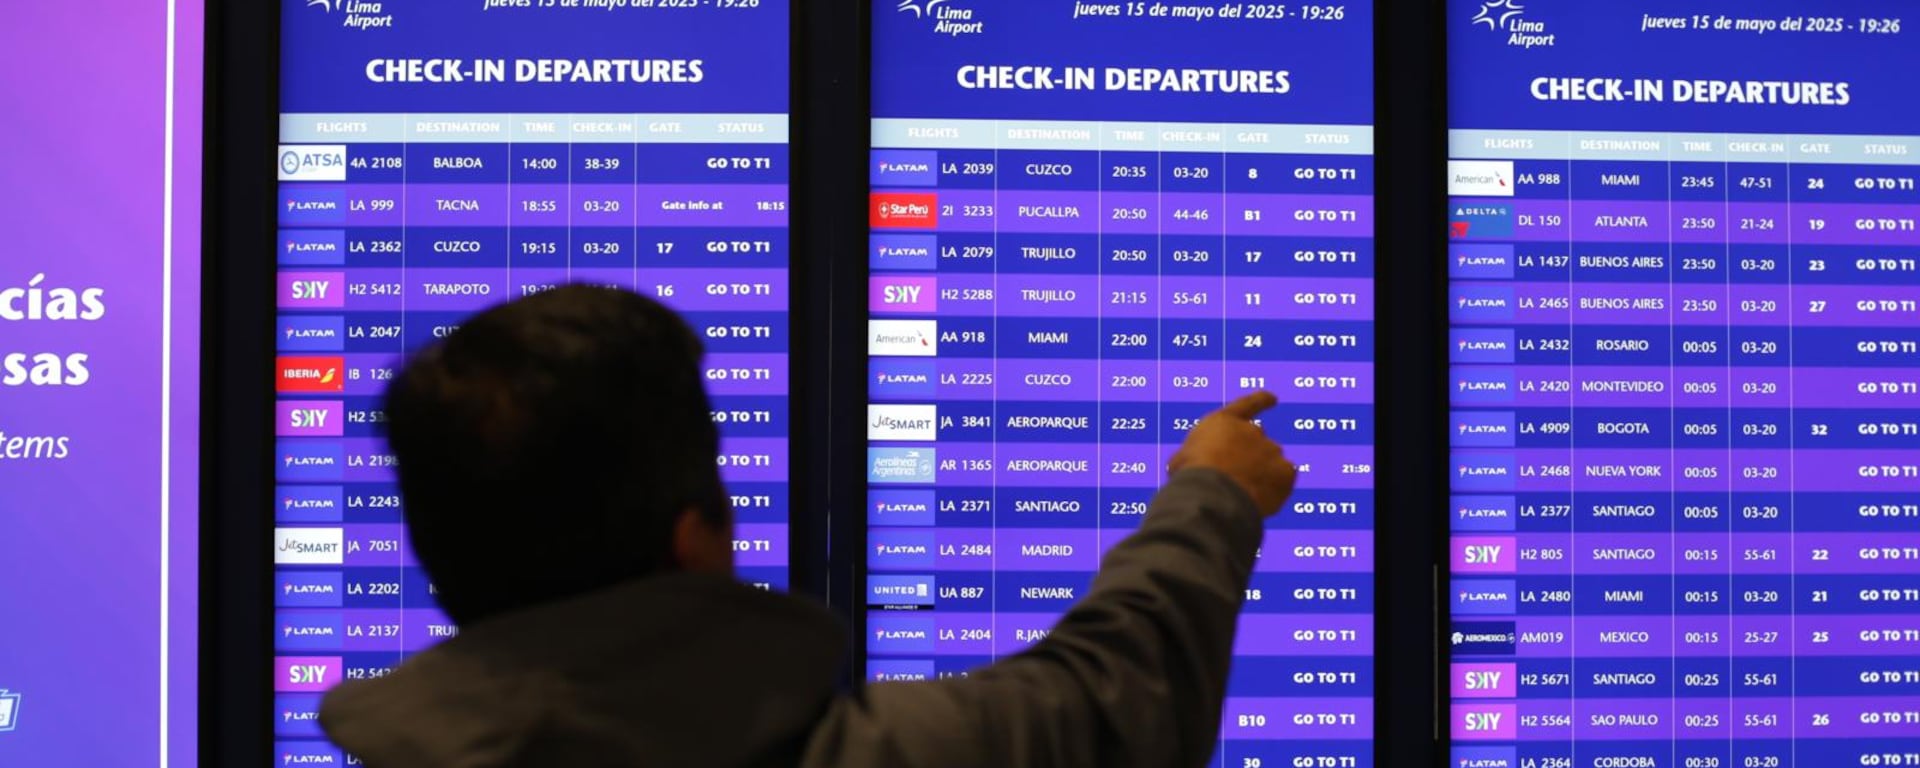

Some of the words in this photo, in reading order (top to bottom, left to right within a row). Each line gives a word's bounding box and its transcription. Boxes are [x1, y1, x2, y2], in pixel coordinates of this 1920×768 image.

[346, 0, 382, 13] Lima
[937, 6, 973, 20] Lima
[1073, 0, 1121, 19] jueves
[1127, 2, 1145, 17] 15
[1148, 2, 1168, 17] de
[1171, 6, 1215, 22] mayo
[1218, 3, 1242, 18] del
[1245, 4, 1285, 19] 2025
[1302, 5, 1345, 20] 19:26
[343, 14, 393, 31] Airport
[934, 21, 983, 37] Airport
[1510, 19, 1544, 32] Lima
[1641, 13, 1687, 32] jueves
[1692, 15, 1710, 29] 15
[1713, 15, 1732, 30] de
[1735, 19, 1777, 34] mayo
[1779, 16, 1803, 31] del
[1805, 17, 1844, 32] 2025
[1860, 18, 1900, 33] 19:26
[1508, 33, 1555, 49] Airport
[365, 58, 505, 83] CHECK-IN
[515, 59, 704, 83] DEPARTURES
[956, 65, 1095, 90] CHECK-IN
[1105, 67, 1290, 94] DEPARTURES
[1530, 77, 1664, 102] CHECK-IN
[1672, 79, 1850, 106] DEPARTURES
[316, 122, 367, 133] FLIGHTS
[416, 122, 500, 133] DESTINATION
[525, 122, 555, 133] TIME
[572, 122, 632, 133] CHECK-IN
[649, 122, 681, 133] GATE
[718, 122, 764, 133] STATUS
[908, 127, 959, 138] FLIGHTS
[1007, 128, 1091, 140] DESTINATION
[1114, 130, 1143, 141] TIME
[1161, 131, 1220, 142] CHECK-IN
[1237, 132, 1268, 143] GATE
[1305, 133, 1349, 144] STATUS
[1484, 138, 1533, 149] FLIGHTS
[1580, 139, 1660, 151] DESTINATION
[1683, 141, 1711, 152] TIME
[1728, 142, 1784, 153] CHECK-IN
[1800, 143, 1830, 153] GATE
[1864, 144, 1907, 155] STATUS
[302, 153, 343, 166] ATSA
[350, 157, 368, 168] 4A
[371, 157, 403, 169] 2108
[433, 157, 483, 169] BALBOA
[523, 158, 557, 169] 14:00
[585, 158, 620, 170] 38-39
[706, 157, 728, 169] GO
[731, 157, 751, 169] TO
[753, 157, 770, 169] T1
[888, 163, 929, 174] LATAM
[942, 163, 958, 174] LA
[963, 163, 994, 175] 2039
[1025, 163, 1073, 176] CUZCO
[1112, 166, 1147, 178] 20:35
[1173, 167, 1209, 179] 03-20
[1248, 168, 1258, 179] 8
[1293, 167, 1315, 179] GO
[1317, 168, 1337, 180] TO
[1339, 168, 1356, 180] T1
[1455, 173, 1494, 185] American
[1517, 173, 1535, 184] AA
[1537, 173, 1561, 185] 988
[1601, 174, 1640, 185] MIAMI
[1681, 176, 1714, 188] 23:45
[1740, 177, 1772, 189] 47-51
[1807, 178, 1825, 189] 24
[1854, 177, 1875, 189] GO
[1877, 177, 1896, 190] TO
[1898, 178, 1914, 190] T1
[296, 201, 337, 212] LATAM
[350, 199, 366, 211] LA
[370, 199, 395, 211] 999
[435, 199, 480, 211] TACNA
[522, 200, 557, 212] 18:55
[583, 200, 620, 212] 03-20
[661, 200, 687, 210] Gate
[688, 200, 710, 210] info
[711, 201, 724, 210] at
[756, 201, 785, 211] 18:15
[1465, 207, 1497, 216] DELTA
[963, 205, 994, 217] 3233
[1018, 205, 1080, 218] PUCALLPA
[1112, 208, 1147, 220] 20:50
[1173, 209, 1209, 221] 44-46
[1244, 209, 1261, 221] B1
[1518, 214, 1534, 226] DL
[1539, 215, 1561, 226] 150
[1594, 215, 1648, 227] ATLANTA
[1682, 217, 1716, 229] 23:50
[1740, 218, 1774, 230] 21-24
[1809, 219, 1825, 231] 19
[349, 241, 365, 253] LA
[370, 241, 402, 253] 2362
[433, 240, 481, 253] CUZCO
[522, 242, 556, 254] 19:15
[583, 242, 620, 254] 03-20
[656, 242, 674, 254] 17
[1579, 256, 1629, 268] BUENOS
[1631, 256, 1664, 268] AIRES
[0, 272, 105, 320] cías
[423, 283, 491, 295] TARAPOTO
[1020, 289, 1076, 303] TRUJILLO
[875, 332, 916, 345] American
[940, 331, 959, 343] AA
[961, 331, 986, 343] 918
[1028, 332, 1068, 344] MIAMI
[1111, 333, 1147, 346] 22:00
[1172, 334, 1207, 347] 47-51
[1244, 335, 1262, 348] 24
[2, 352, 89, 386] sas
[284, 368, 321, 379] IBERIA
[1239, 376, 1265, 389] B11
[1468, 381, 1507, 391] LATAM
[1519, 380, 1535, 392] LA
[1539, 380, 1570, 392] 2420
[1581, 380, 1664, 393] MONTEVIDEO
[939, 459, 957, 471] AR
[962, 459, 992, 471] 1365
[1007, 459, 1088, 473] AEROPARQUE
[1585, 465, 1626, 477] NUEVA
[1628, 465, 1661, 477] YORK
[347, 540, 361, 554] JA
[369, 540, 398, 552] 7051
[873, 586, 916, 595] UNITED
[939, 587, 958, 598] UA
[960, 587, 984, 599] 887
[1020, 587, 1074, 599] NEWARK
[1520, 631, 1564, 643] AM019
[1599, 631, 1649, 643] MEXICO
[1685, 632, 1719, 643] 00:15
[1744, 631, 1778, 643] 25-27
[1812, 631, 1829, 643] 25
[1238, 714, 1266, 727] B10
[1293, 713, 1314, 725] GO
[1316, 713, 1337, 725] TO
[1339, 713, 1356, 725] T1
[1520, 715, 1538, 727] H2
[1541, 715, 1571, 726] 5564
[1591, 714, 1616, 726] SAO
[1619, 714, 1659, 726] PAULO
[1684, 714, 1719, 727] 00:25
[1744, 714, 1777, 726] 55-61
[1812, 713, 1830, 726] 26
